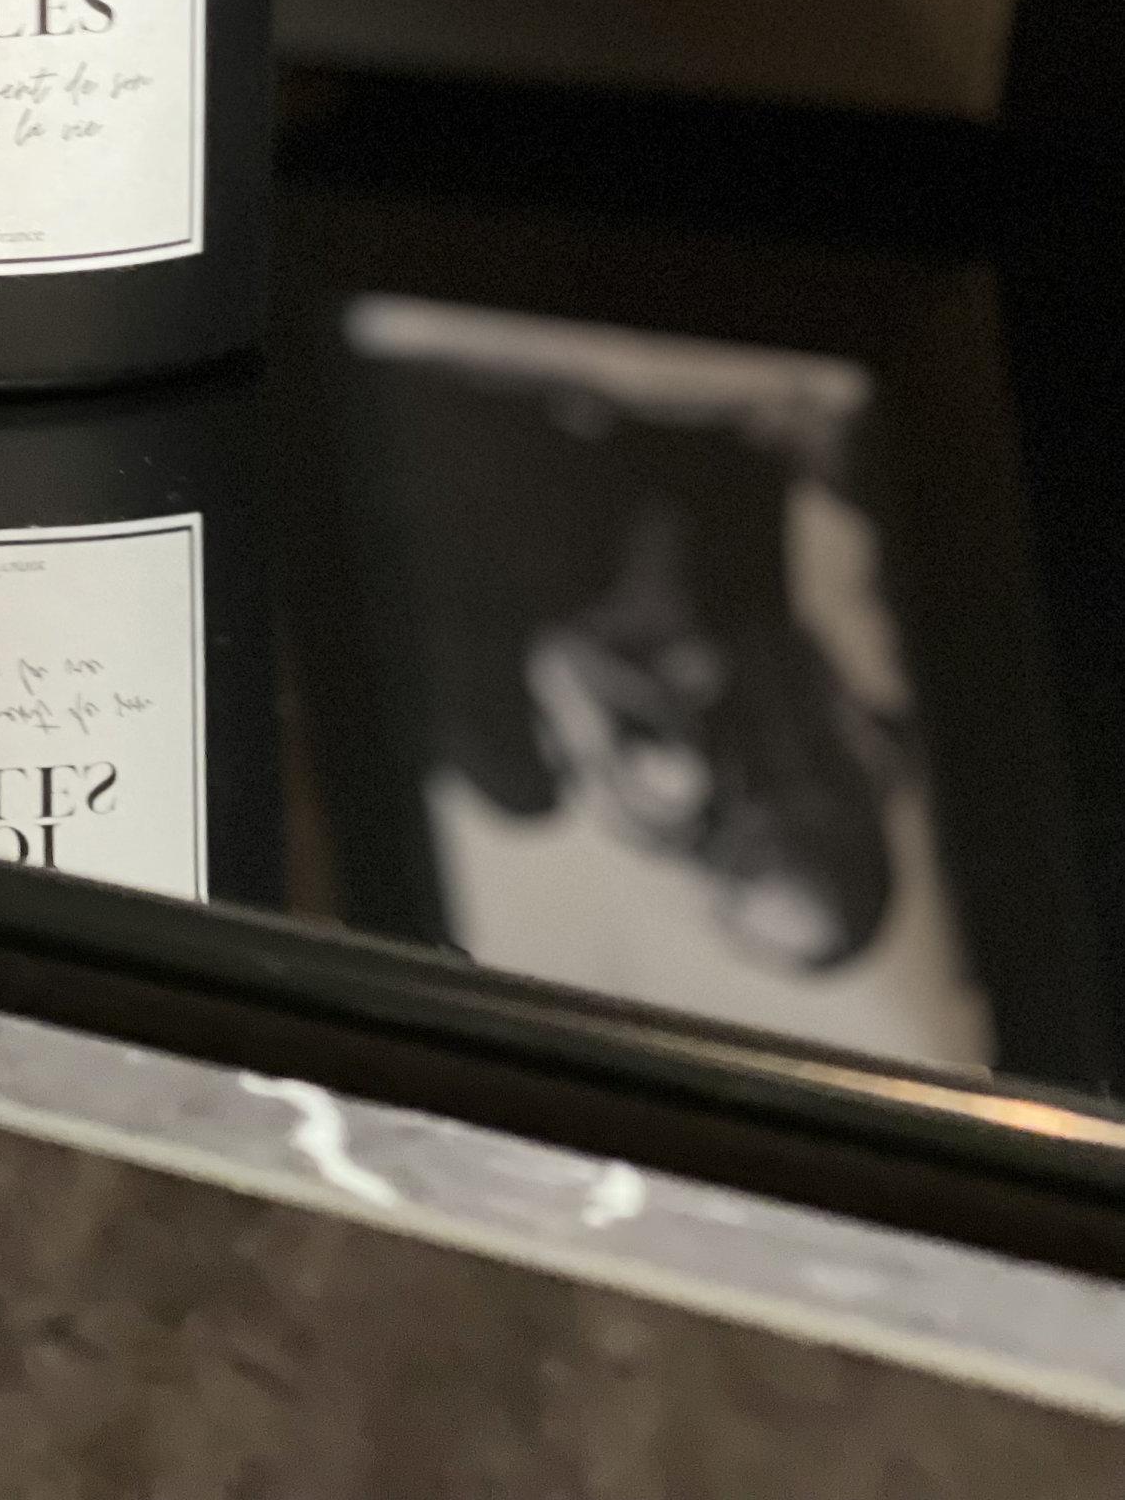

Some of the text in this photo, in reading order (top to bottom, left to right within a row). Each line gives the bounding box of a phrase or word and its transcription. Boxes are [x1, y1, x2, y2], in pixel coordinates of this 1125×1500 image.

[65, 60, 99, 105] de
[14, 107, 47, 146] la
[60, 120, 105, 142] vie
